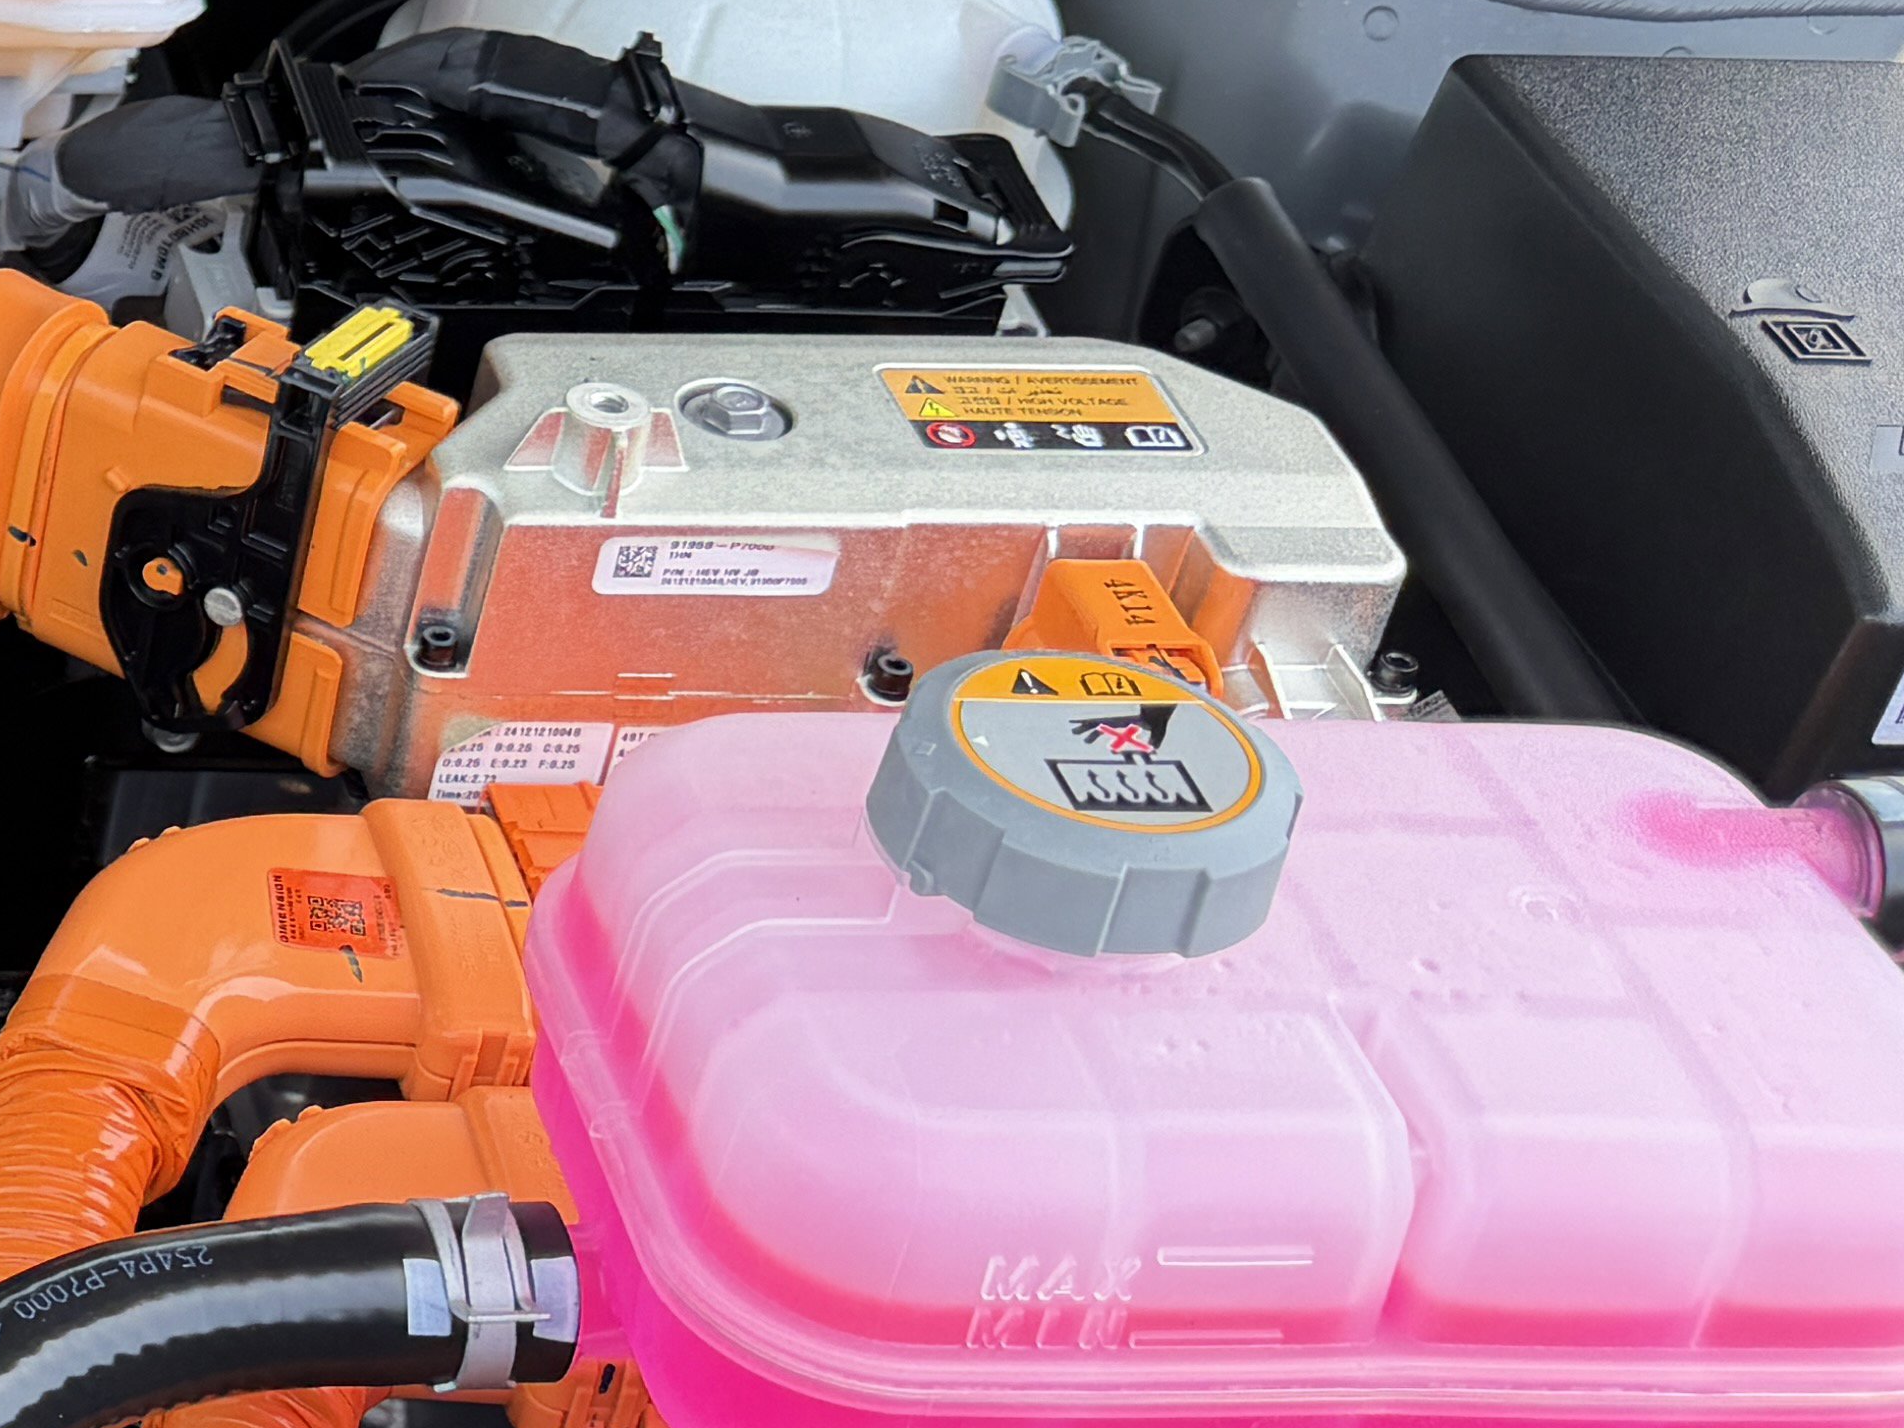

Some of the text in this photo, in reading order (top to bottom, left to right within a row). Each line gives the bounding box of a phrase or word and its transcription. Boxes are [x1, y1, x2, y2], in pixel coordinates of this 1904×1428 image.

[944, 375, 1010, 384] WARNING
[1026, 376, 1138, 385] AVERTISSEMENT
[1018, 397, 1054, 406] HIGH
[1057, 397, 1129, 407] VOLTAGE
[963, 407, 1082, 417] HAUTE TENSION
[1103, 578, 1157, 626] 4K14
[13, 1243, 214, 1320] 254P4-P7000
[980, 1254, 1142, 1301] MAX
[965, 1305, 1128, 1350] MIN
